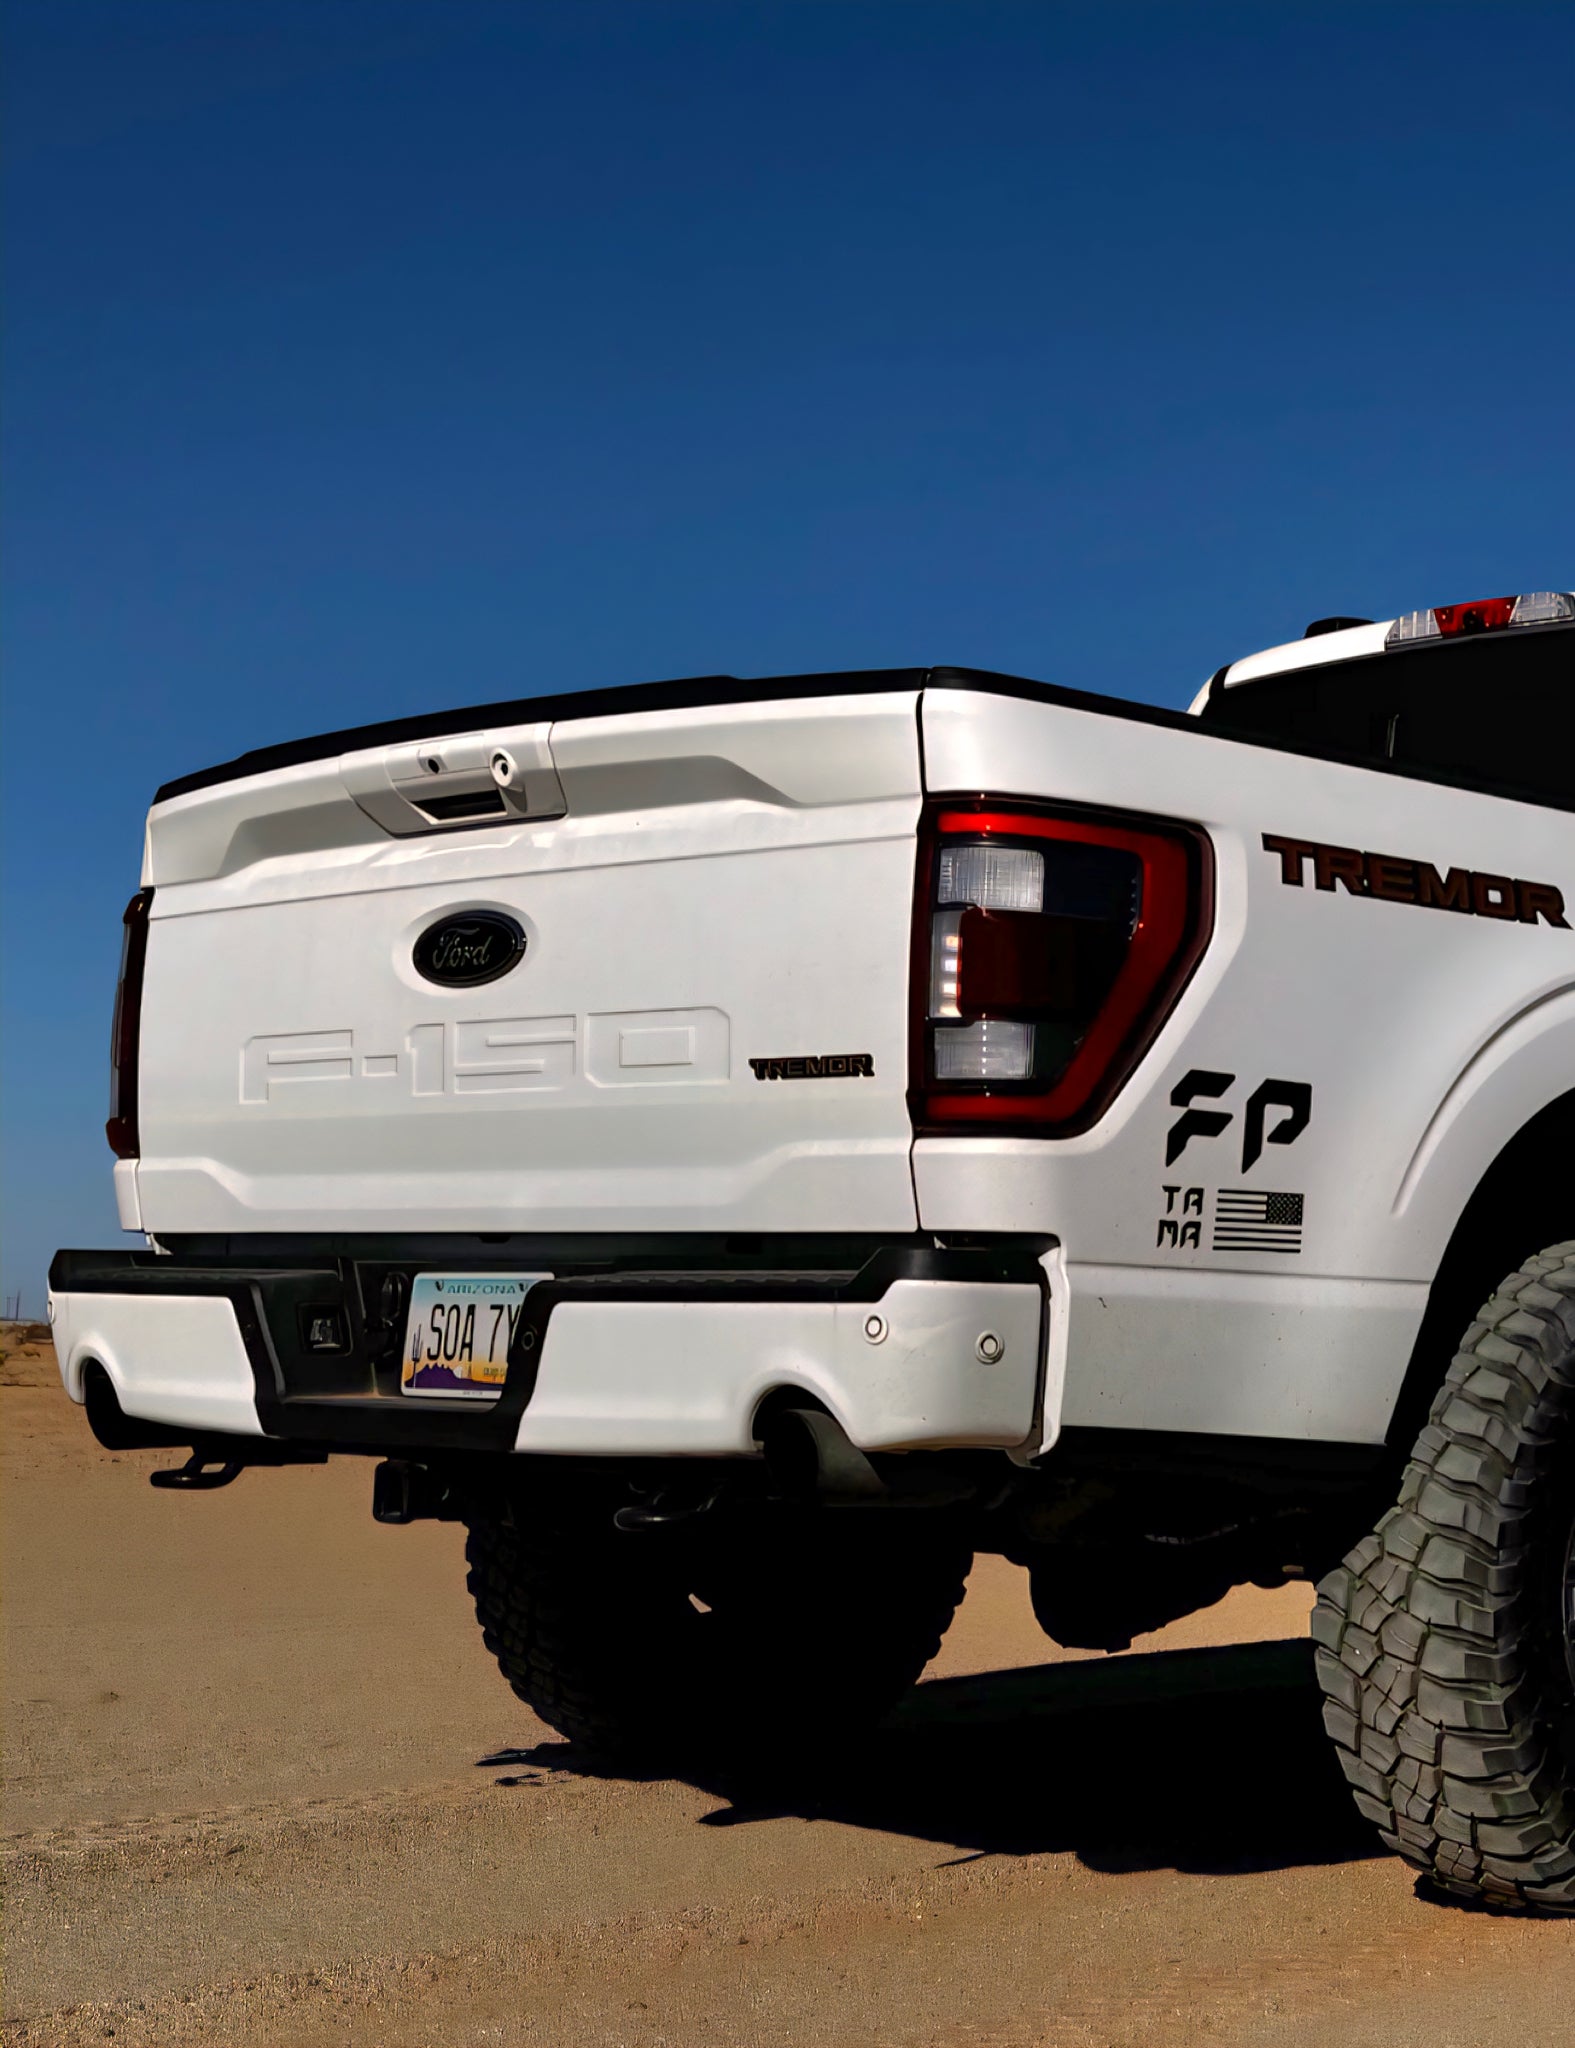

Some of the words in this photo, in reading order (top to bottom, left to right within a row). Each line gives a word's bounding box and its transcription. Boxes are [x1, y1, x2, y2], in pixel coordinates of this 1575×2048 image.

[1261, 833, 1574, 930] TREMOR
[432, 927, 493, 969] Ford
[239, 1006, 731, 1104] F-150
[748, 1054, 875, 1081] TREMOR
[1165, 1069, 1312, 1174] FP
[447, 1284, 516, 1294] ARIZONA
